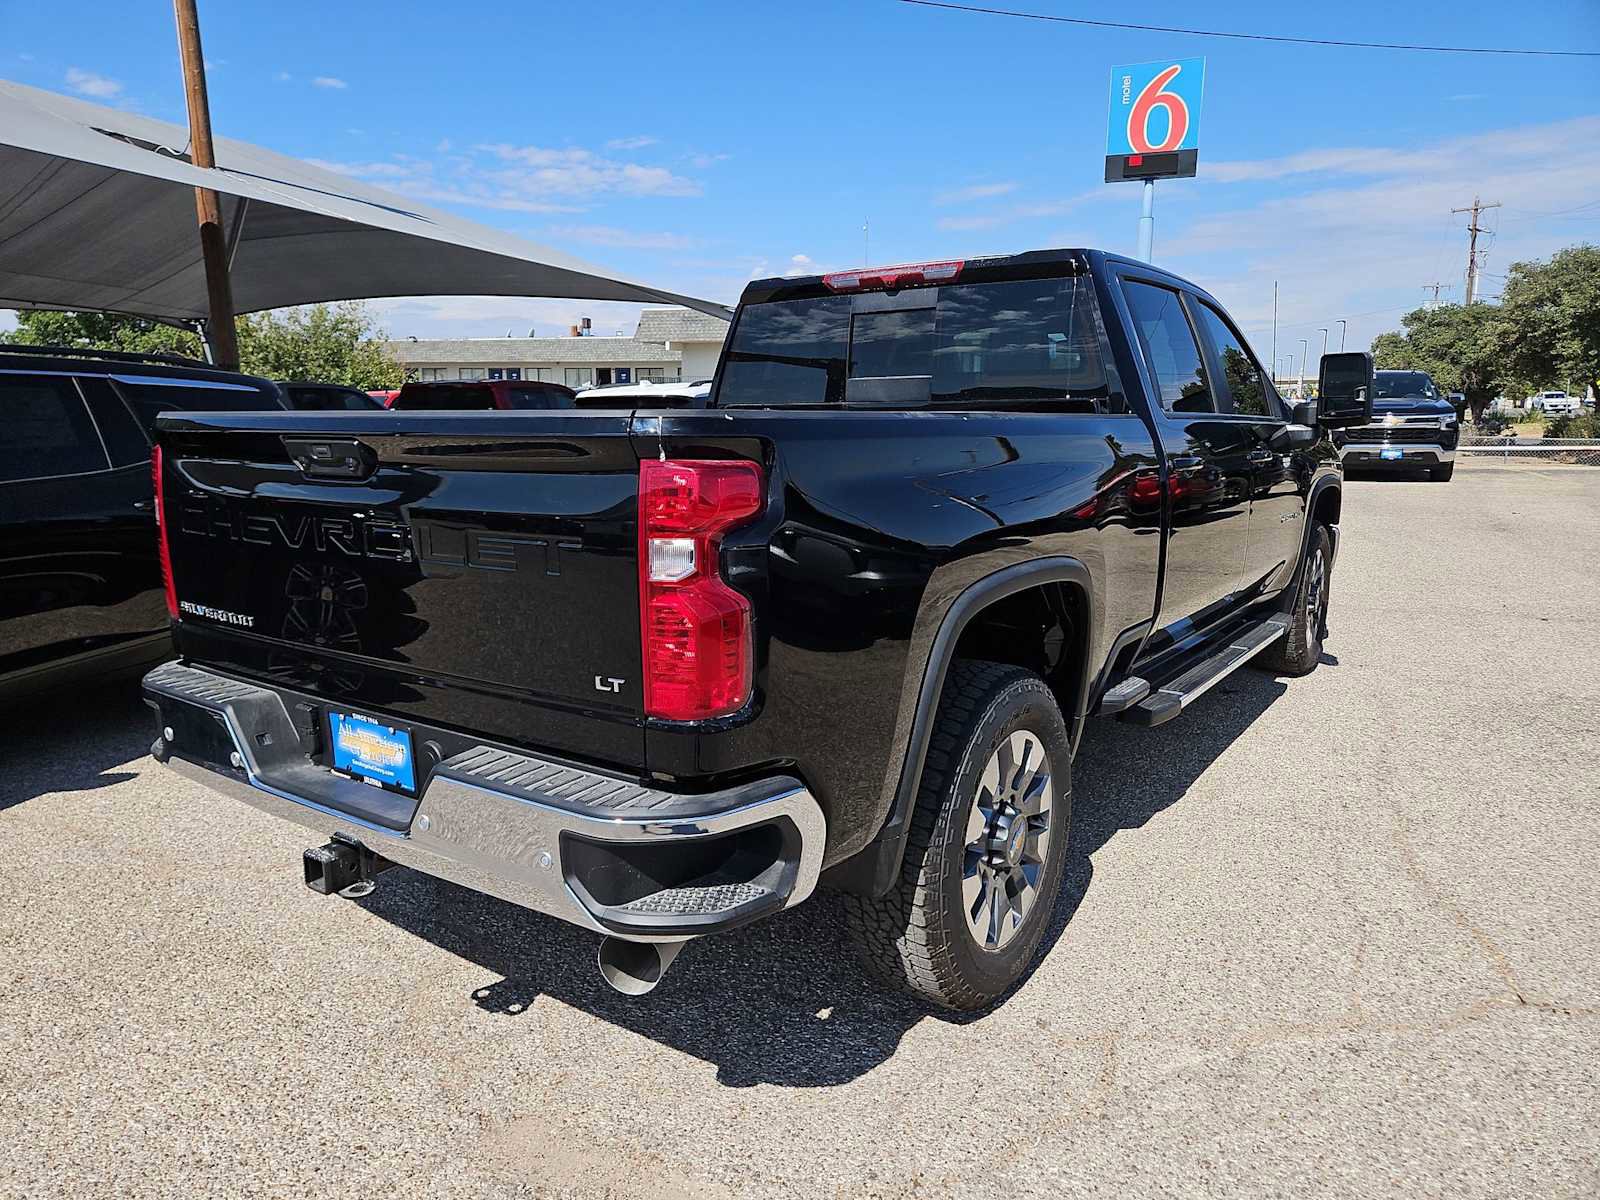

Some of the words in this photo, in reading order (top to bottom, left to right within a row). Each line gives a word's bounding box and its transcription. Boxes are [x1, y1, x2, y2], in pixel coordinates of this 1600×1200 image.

[1121, 75, 1132, 105] motel
[1127, 64, 1189, 153] 6
[180, 496, 583, 576] CHEVROLET
[595, 675, 625, 693] LT
[351, 713, 367, 723] SINCE
